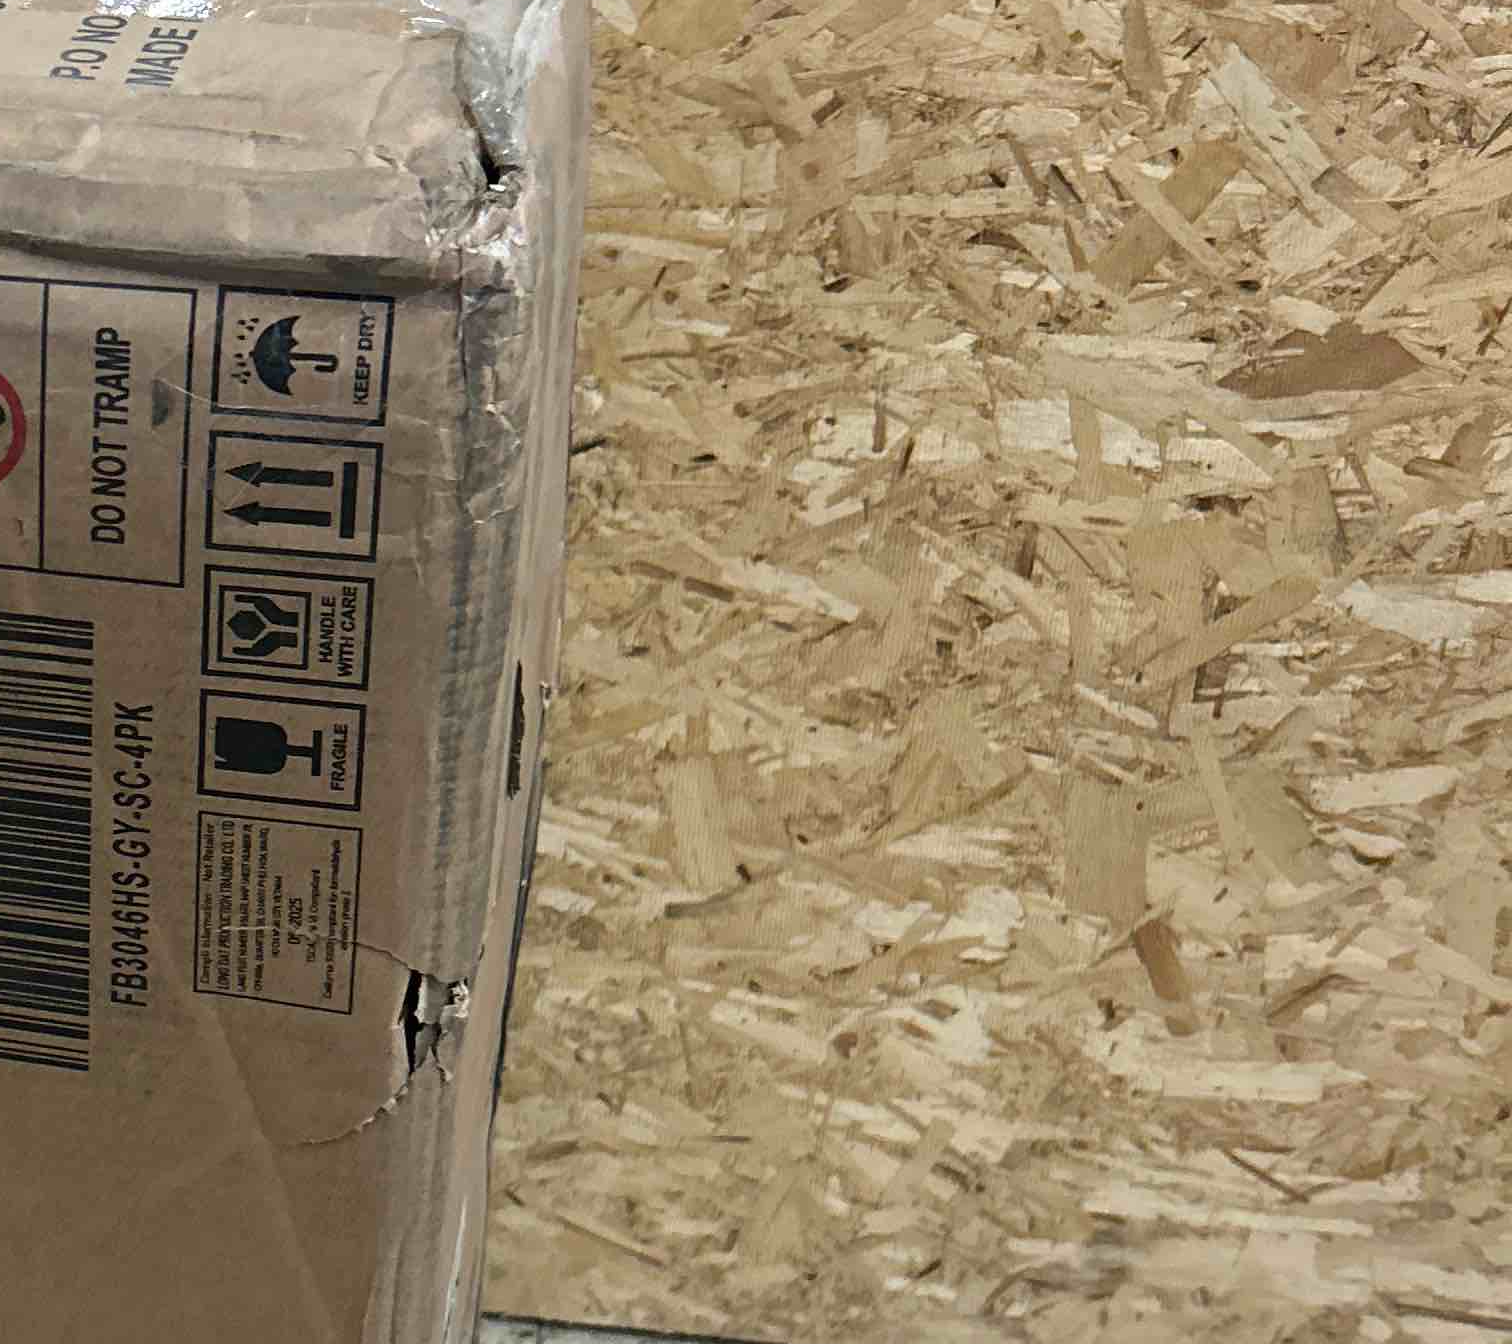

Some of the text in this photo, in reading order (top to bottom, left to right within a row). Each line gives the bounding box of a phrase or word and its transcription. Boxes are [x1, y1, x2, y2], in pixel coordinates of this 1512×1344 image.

[49, 48, 108, 80] P.O
[124, 27, 198, 88] MADE
[352, 309, 377, 405] KEEP DRY
[91, 327, 132, 544] DO NOT TRAMP
[318, 595, 337, 663] HANDLE
[337, 586, 359, 677] WITH CARE
[331, 723, 349, 791] FRAGILE
[111, 702, 153, 1007] FB3046HS-GY-SC-4PK
